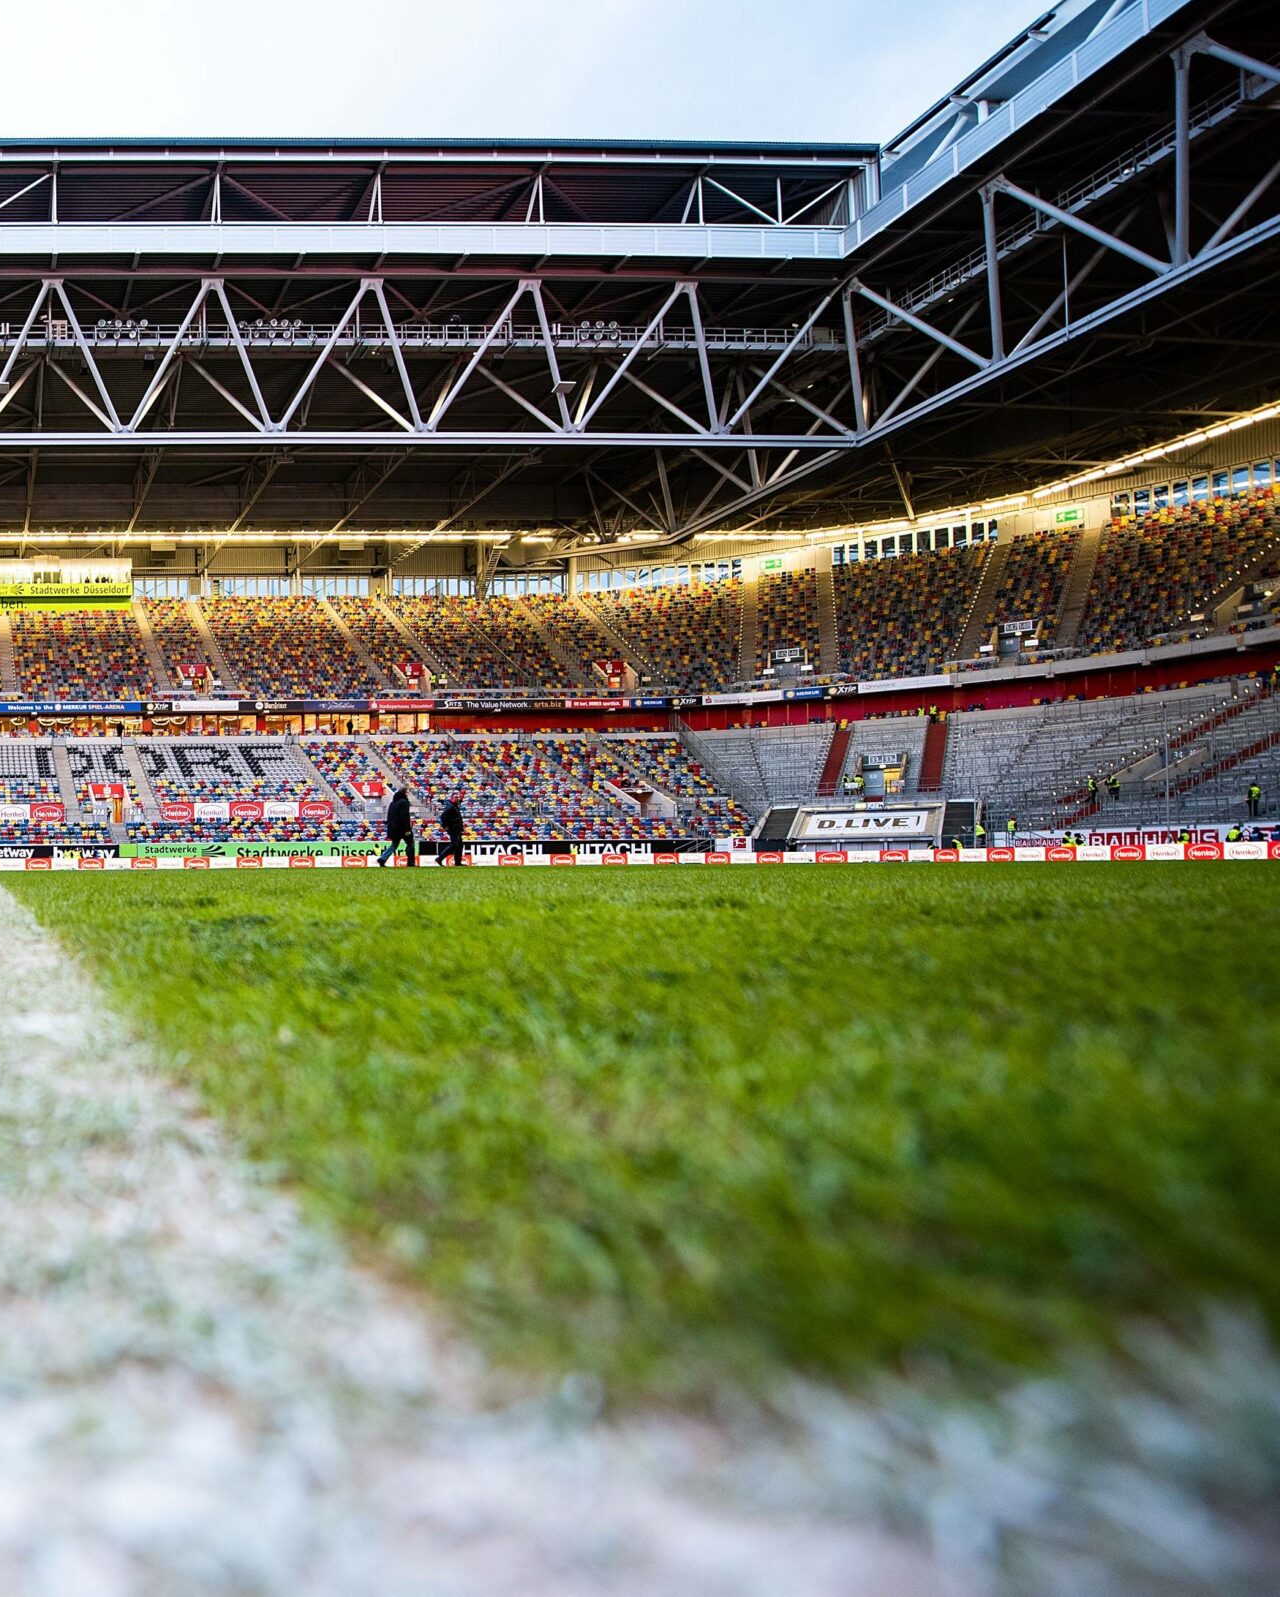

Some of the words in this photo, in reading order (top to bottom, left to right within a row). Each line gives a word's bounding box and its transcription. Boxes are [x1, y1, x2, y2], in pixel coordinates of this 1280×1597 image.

[30, 586, 80, 595] Stadtwerke
[83, 585, 129, 594] Düsseldorf
[36, 810, 60, 818] Henkel
[165, 809, 189, 817] Henkel
[234, 808, 259, 816] Henkel
[302, 808, 327, 816] Henkel
[817, 817, 910, 829] D.LIVE
[144, 845, 198, 854] Stadtwerke
[237, 847, 323, 857] Stadtwerke
[462, 844, 543, 855] HITACHI
[1151, 849, 1179, 857] Henkel
[1231, 848, 1260, 856] Henkel
[1115, 850, 1140, 858] Henkel
